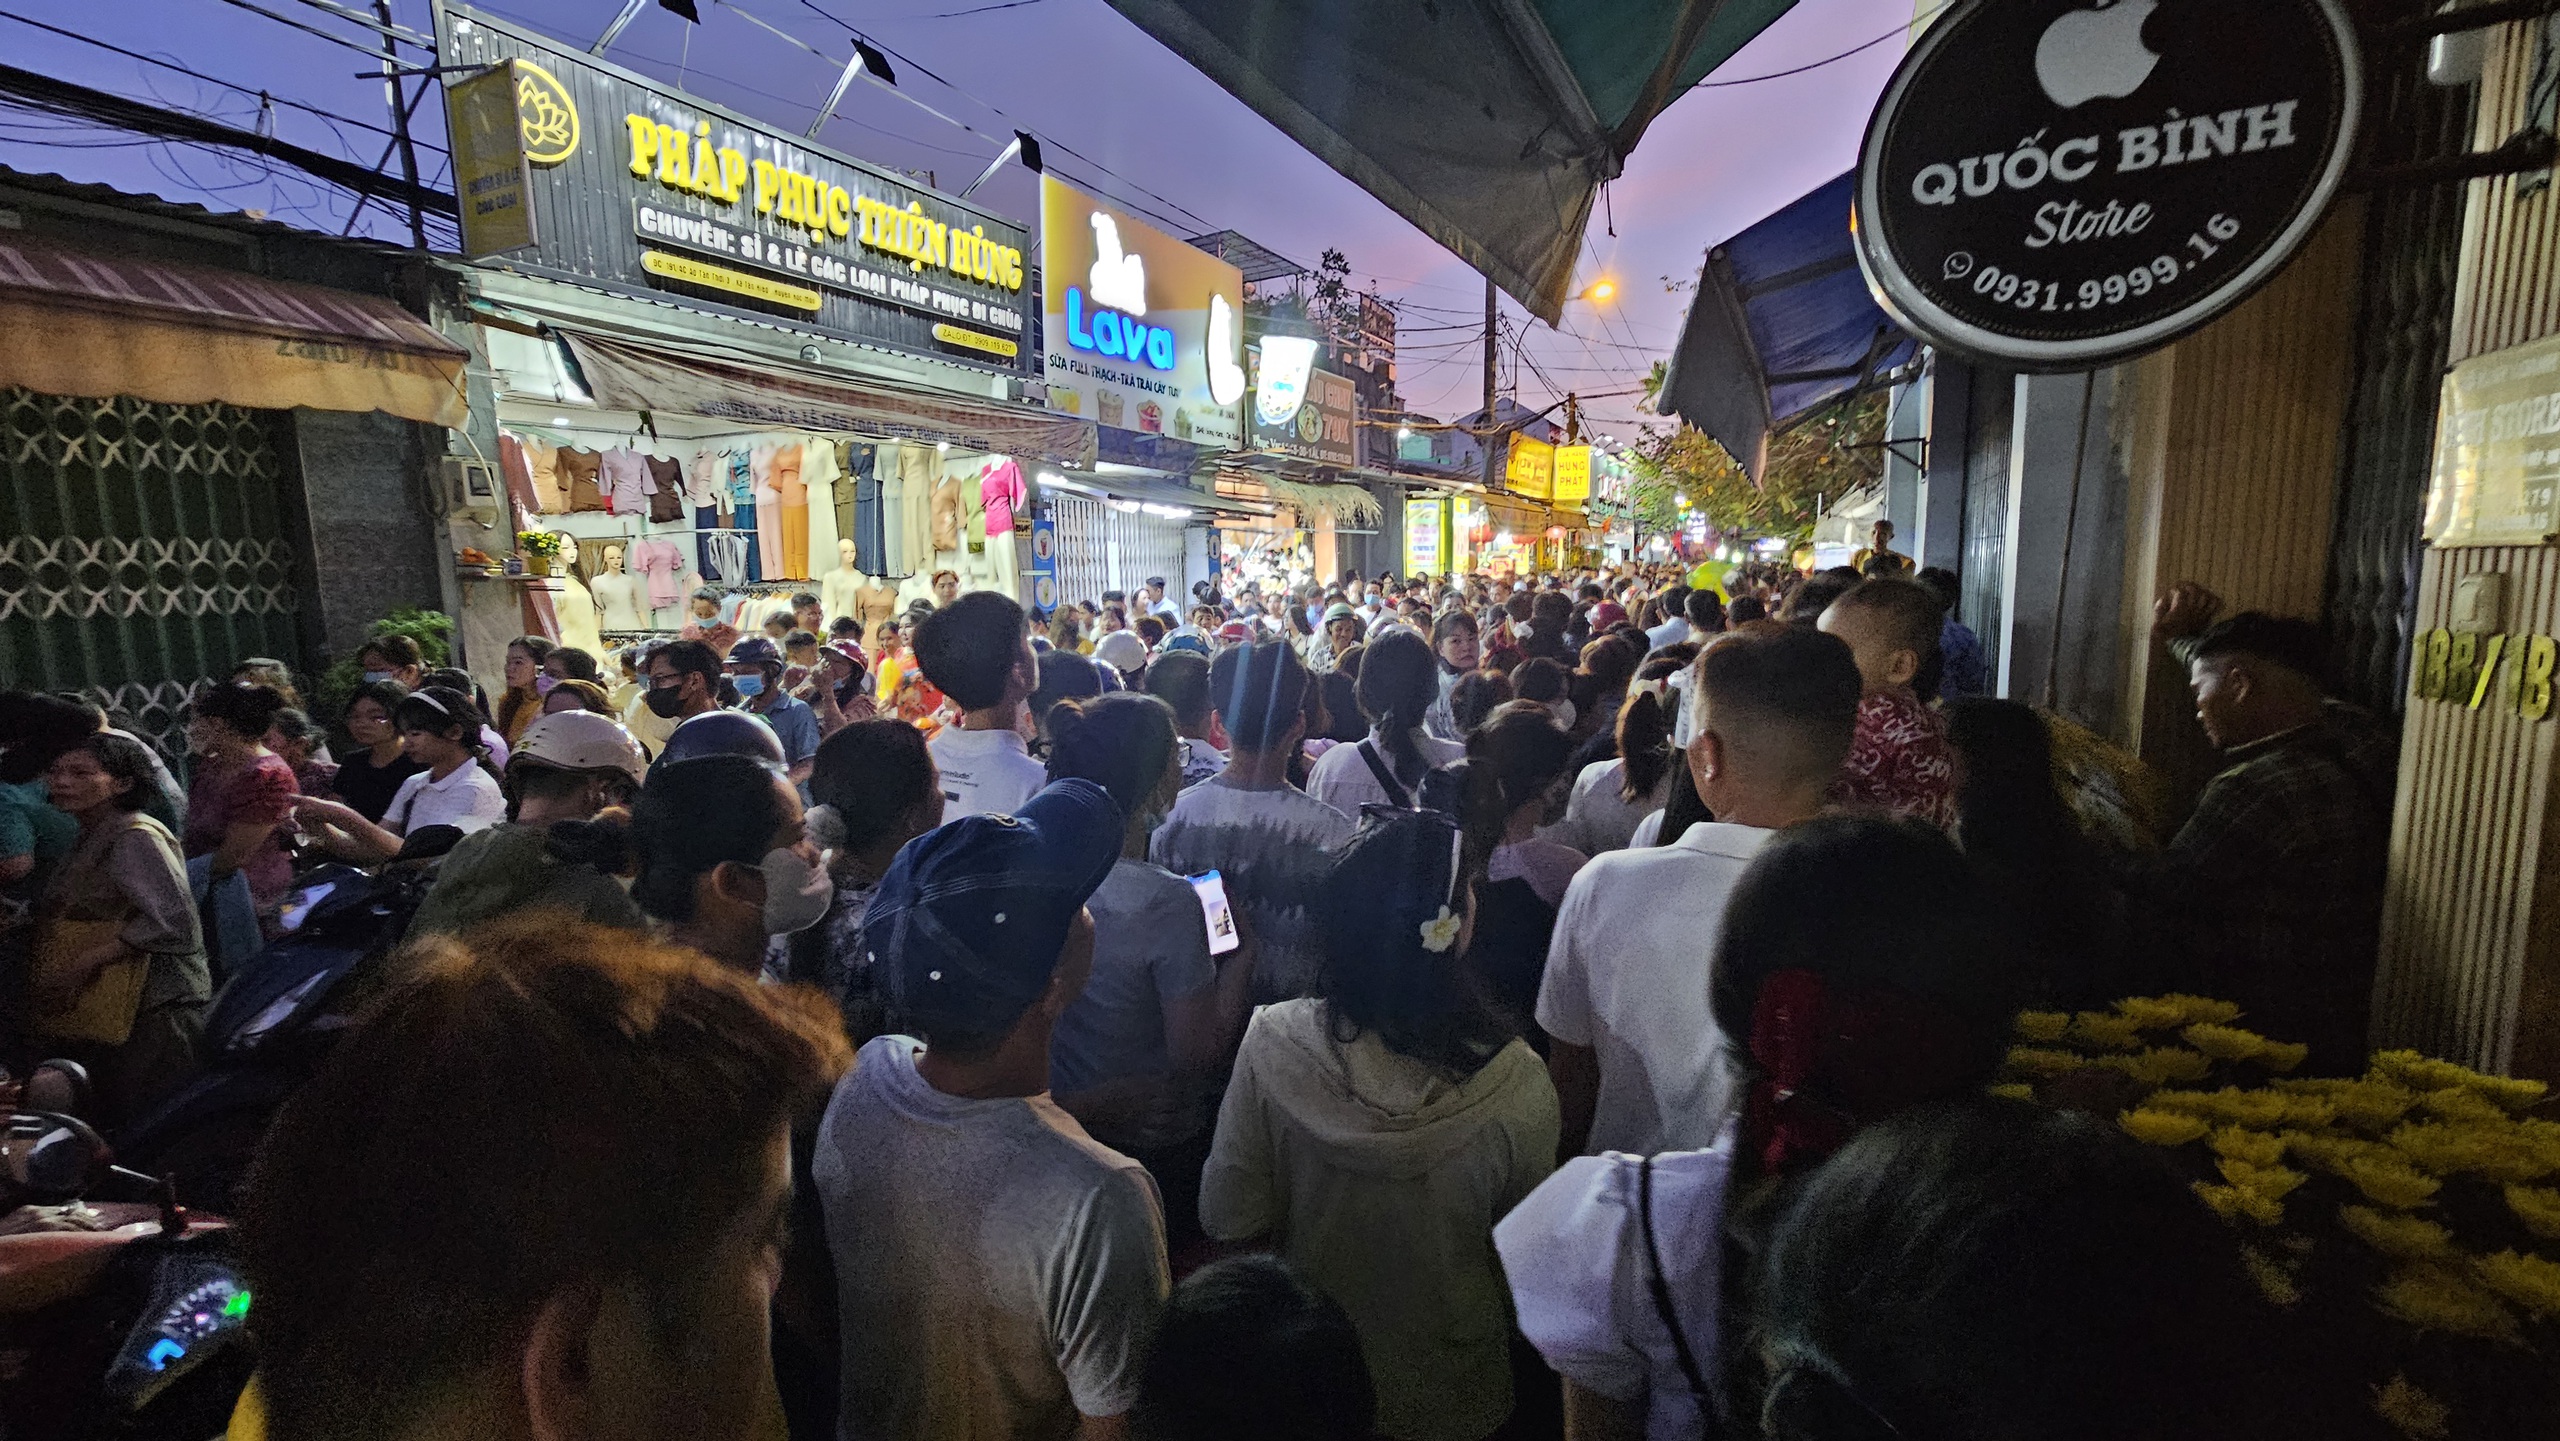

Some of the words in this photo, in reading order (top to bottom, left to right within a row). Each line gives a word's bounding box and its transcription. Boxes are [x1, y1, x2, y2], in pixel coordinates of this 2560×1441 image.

[1912, 127, 2100, 206] QUỐC
[2115, 100, 2298, 173] BÌNH
[626, 113, 747, 204] PHÁP
[751, 158, 850, 243] PHỤC
[852, 194, 947, 273] THIỆN
[949, 225, 1023, 291] HÙNG
[2023, 198, 2155, 248] Store
[766, 243, 781, 265] &
[811, 255, 847, 283] CÁC
[850, 266, 887, 296] LOẠI
[891, 278, 930, 306] PHÁP
[933, 290, 970, 317] PHỤC
[972, 302, 987, 321] ĐI
[989, 306, 1023, 331] CHÙA
[1972, 213, 2240, 311] 0931.9999.16
[1049, 353, 1068, 371] SỮA
[1066, 286, 1175, 371] Lava
